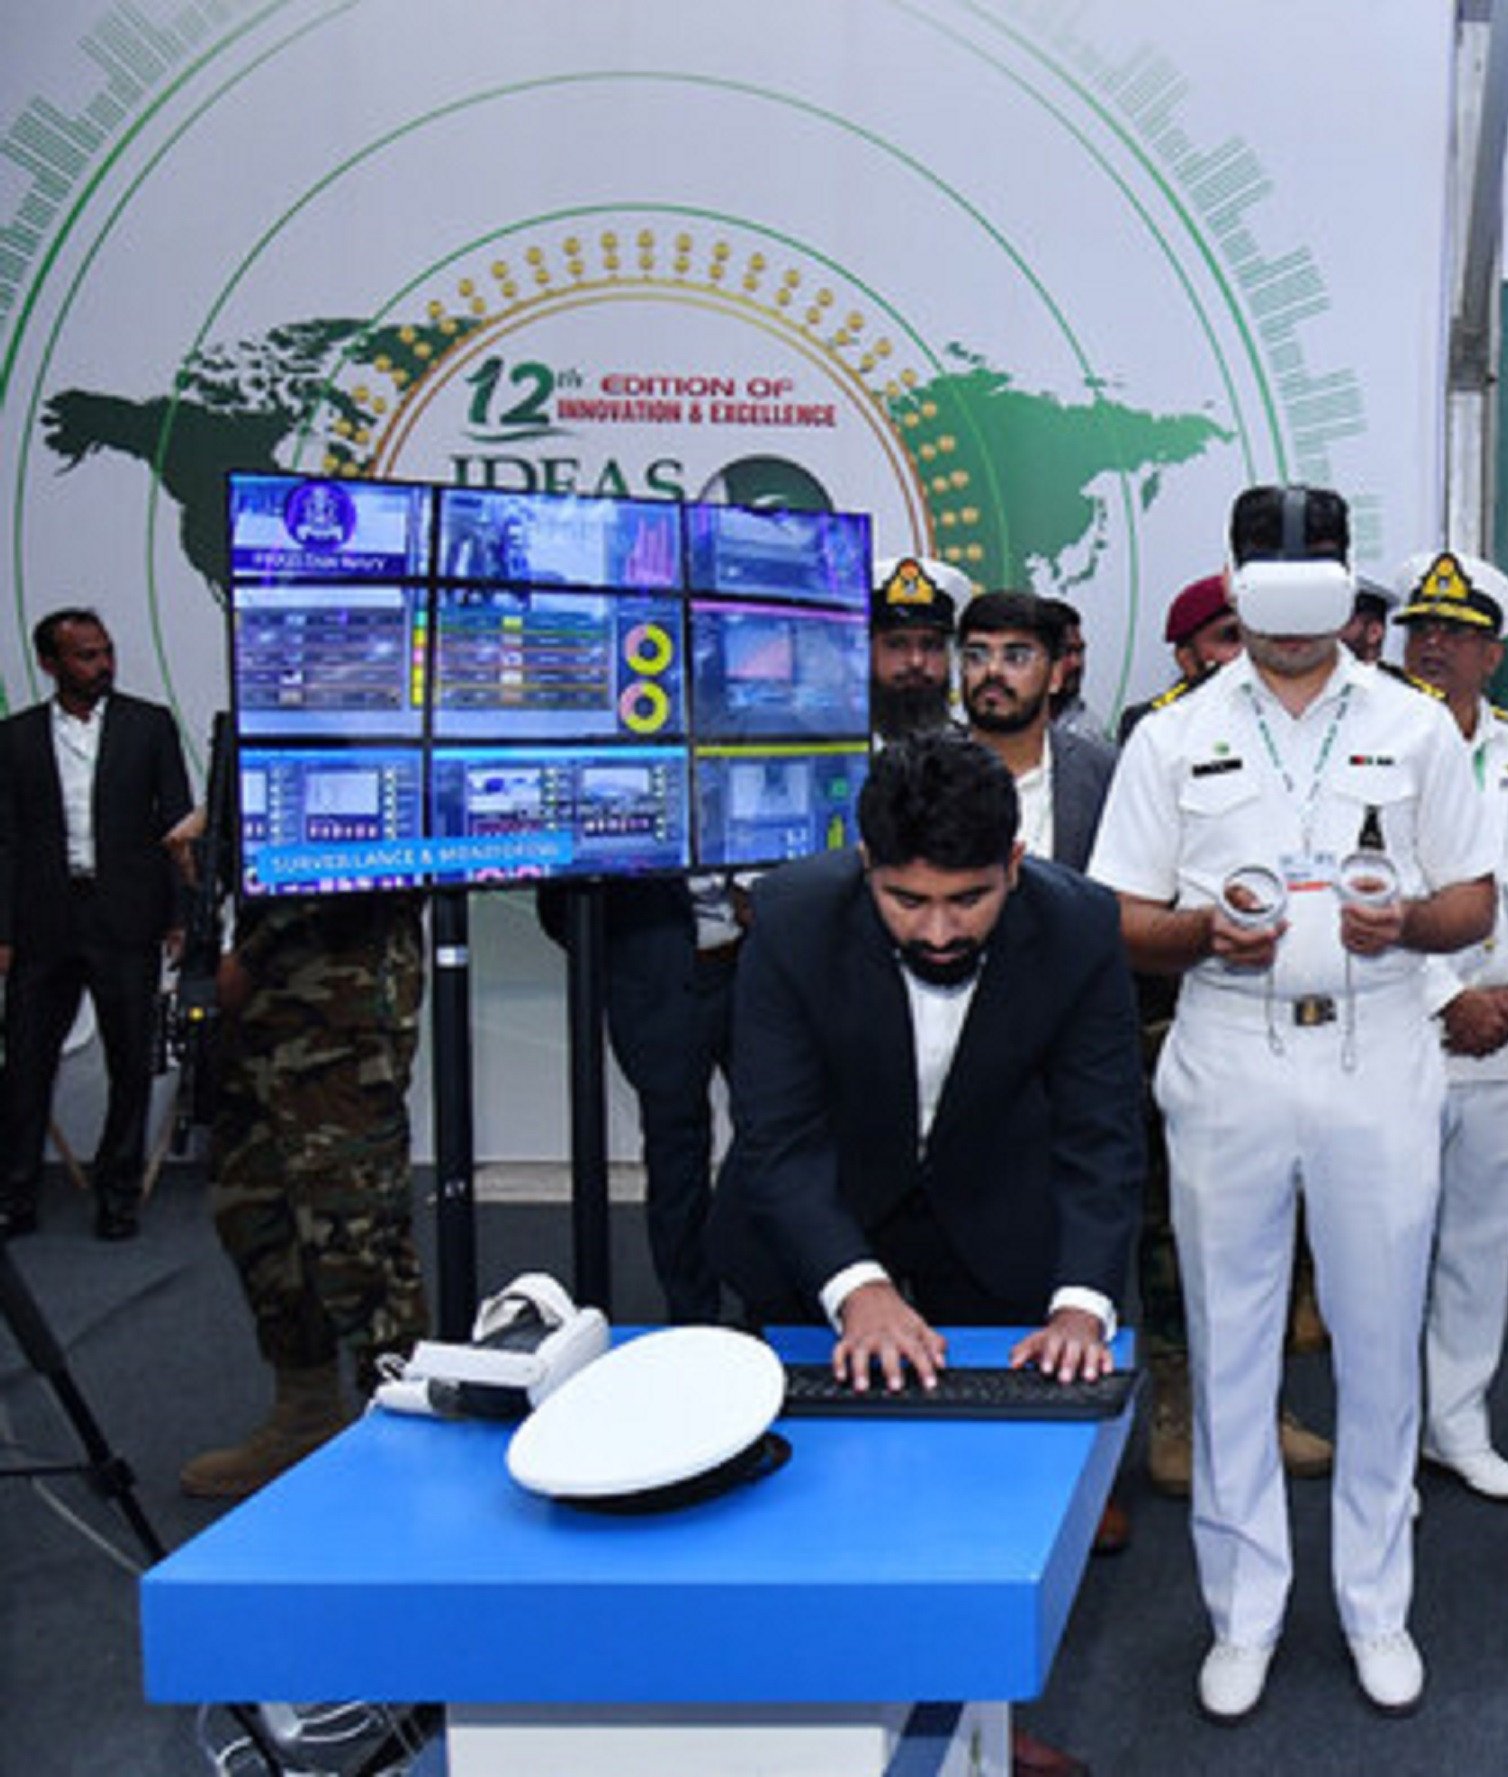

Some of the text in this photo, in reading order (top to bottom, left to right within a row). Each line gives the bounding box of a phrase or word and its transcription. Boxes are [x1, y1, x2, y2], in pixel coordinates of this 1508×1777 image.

[599, 373, 735, 397] EDITION
[746, 377, 794, 399] OF
[557, 398, 837, 428] INNOVATION & EXCELLENCE
[450, 454, 686, 502] IDEAS
